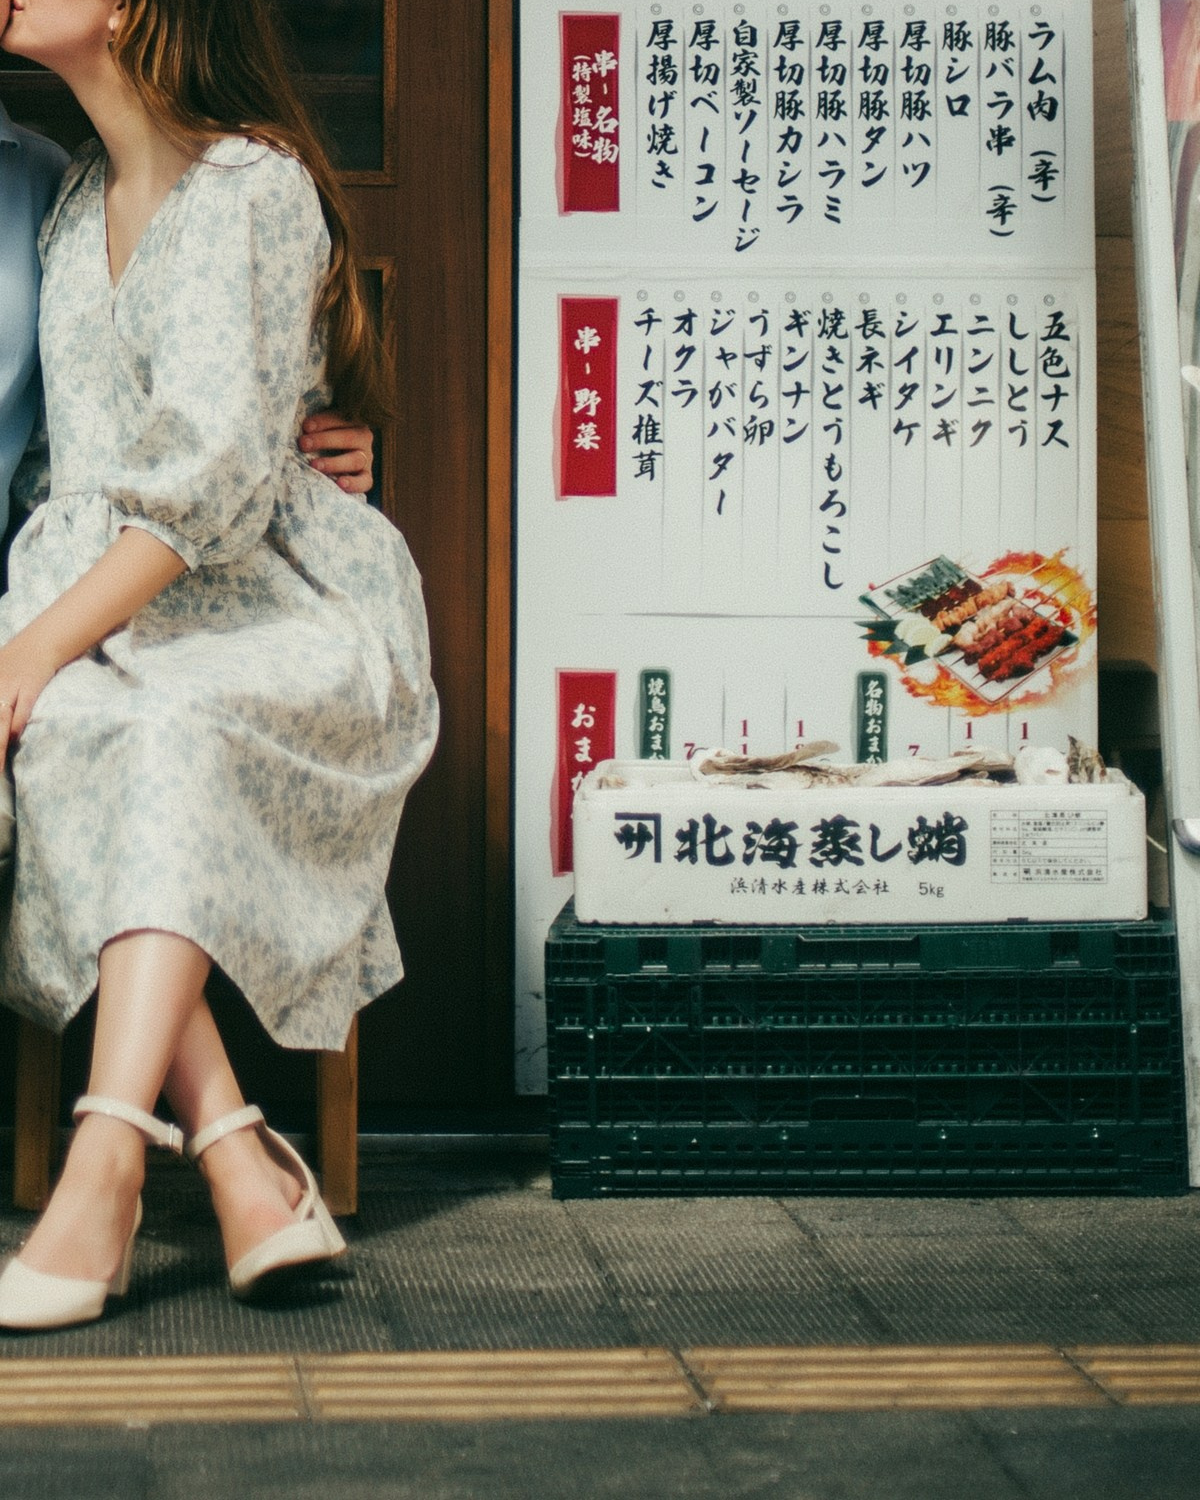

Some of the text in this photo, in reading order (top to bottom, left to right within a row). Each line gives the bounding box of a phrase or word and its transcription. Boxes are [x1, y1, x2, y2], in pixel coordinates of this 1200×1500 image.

[645, 18, 679, 189] 厚揚げ焼き
[688, 18, 721, 223] 厚切ベーコン
[729, 18, 762, 253] 自家製ソーセージ
[772, 19, 806, 224] 厚切豚カシラ
[815, 19, 848, 224] 厚切豚ハラミ
[857, 19, 890, 188] 厚切豚タン
[899, 19, 932, 188] 厚切豚ハツ
[942, 20, 974, 117] 豚シロ
[631, 307, 664, 482] チーズ椎茸
[670, 307, 699, 409] オクラ
[741, 308, 775, 446] うずら卵
[781, 308, 812, 444] ギンナン
[854, 308, 887, 411] 長ネギ
[892, 310, 921, 446] シイタケ
[929, 312, 959, 447] エリンギ
[966, 314, 995, 447] ニンニク
[1007, 311, 1029, 447] ししとう
[1039, 310, 1071, 448] 五色ナス
[817, 307, 850, 590] 焼きとうもろこし
[729, 876, 892, 898] 浜清水産株式会社
[917, 880, 946, 898] 5kg
